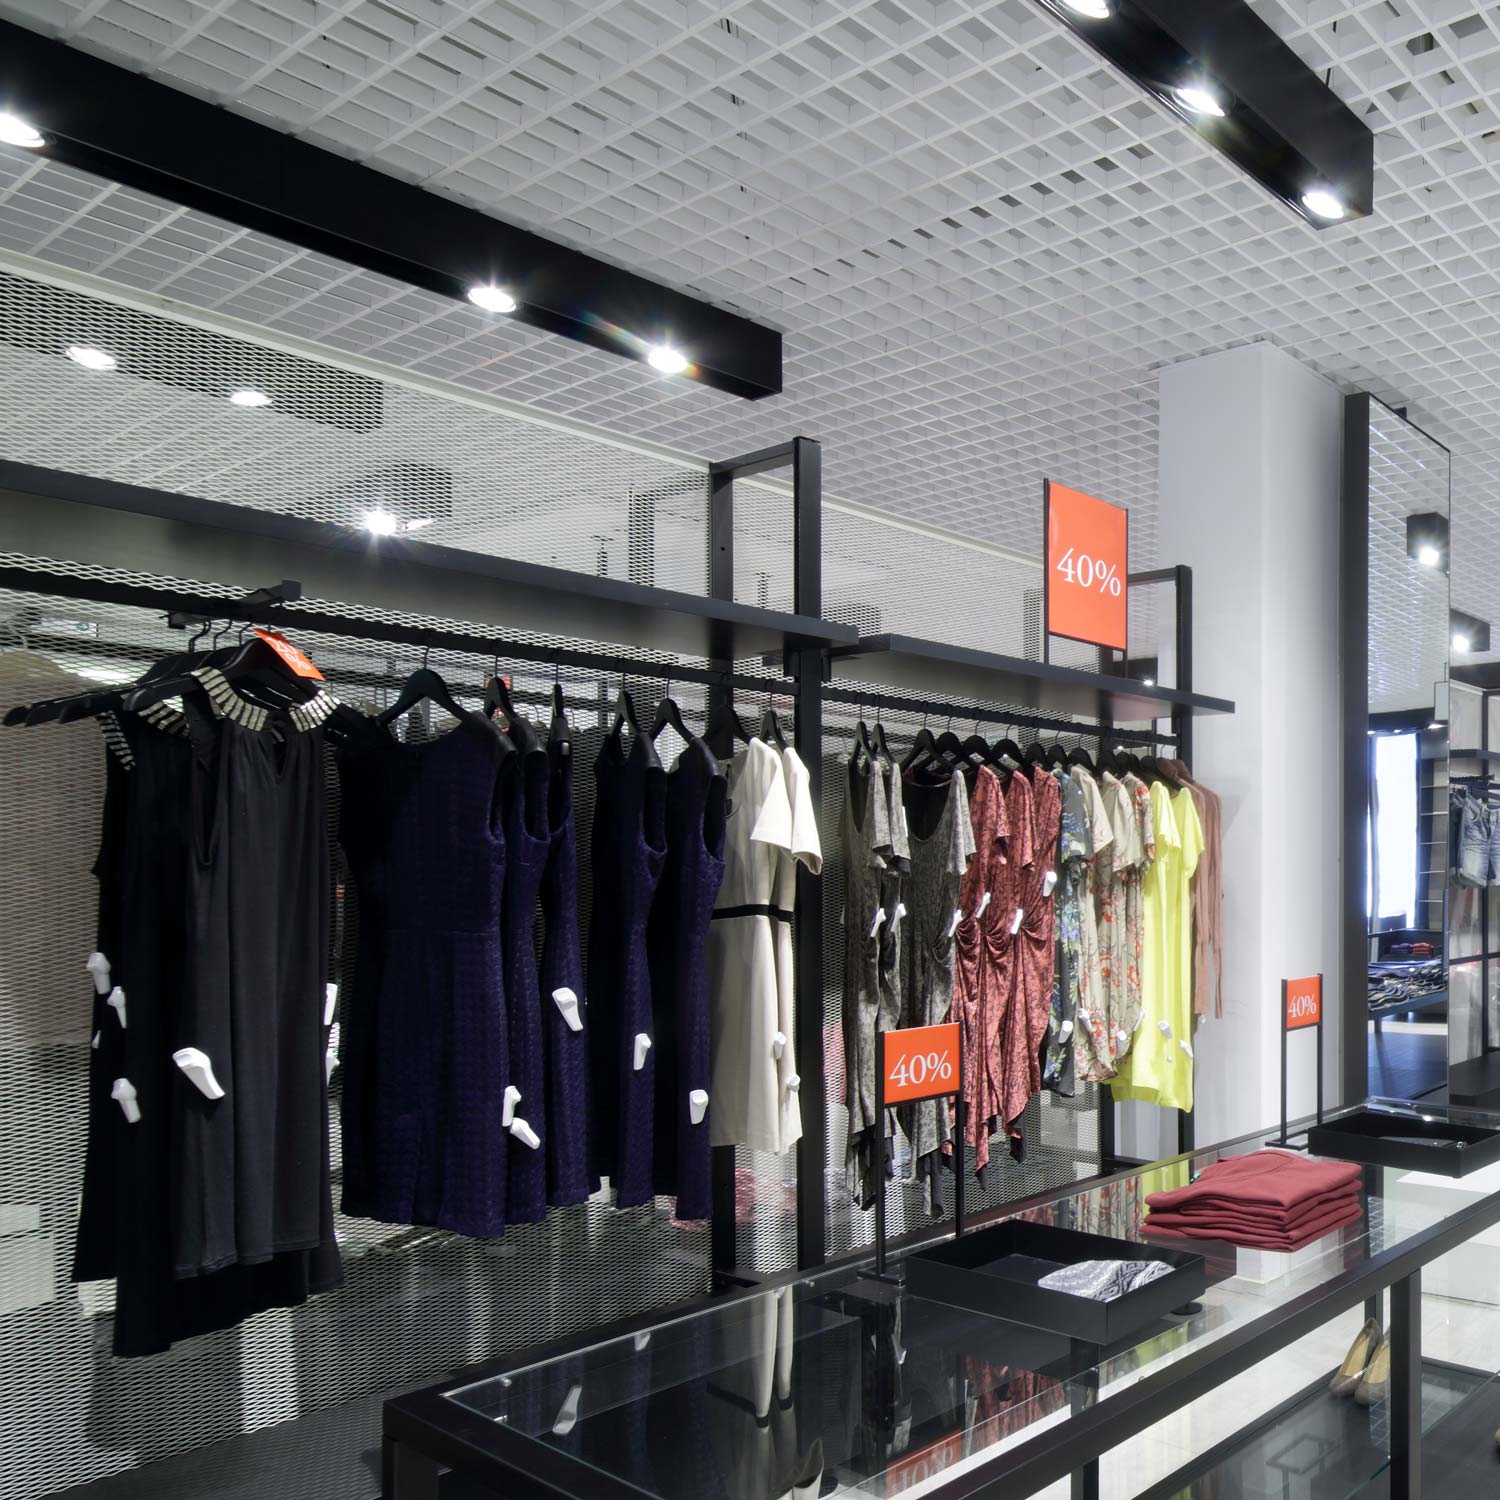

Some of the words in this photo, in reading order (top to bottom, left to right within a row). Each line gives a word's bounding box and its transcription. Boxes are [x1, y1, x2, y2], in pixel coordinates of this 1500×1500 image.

[1057, 547, 1121, 597] 40%
[1288, 994, 1317, 1018] 40%
[889, 1050, 952, 1087] 40%
